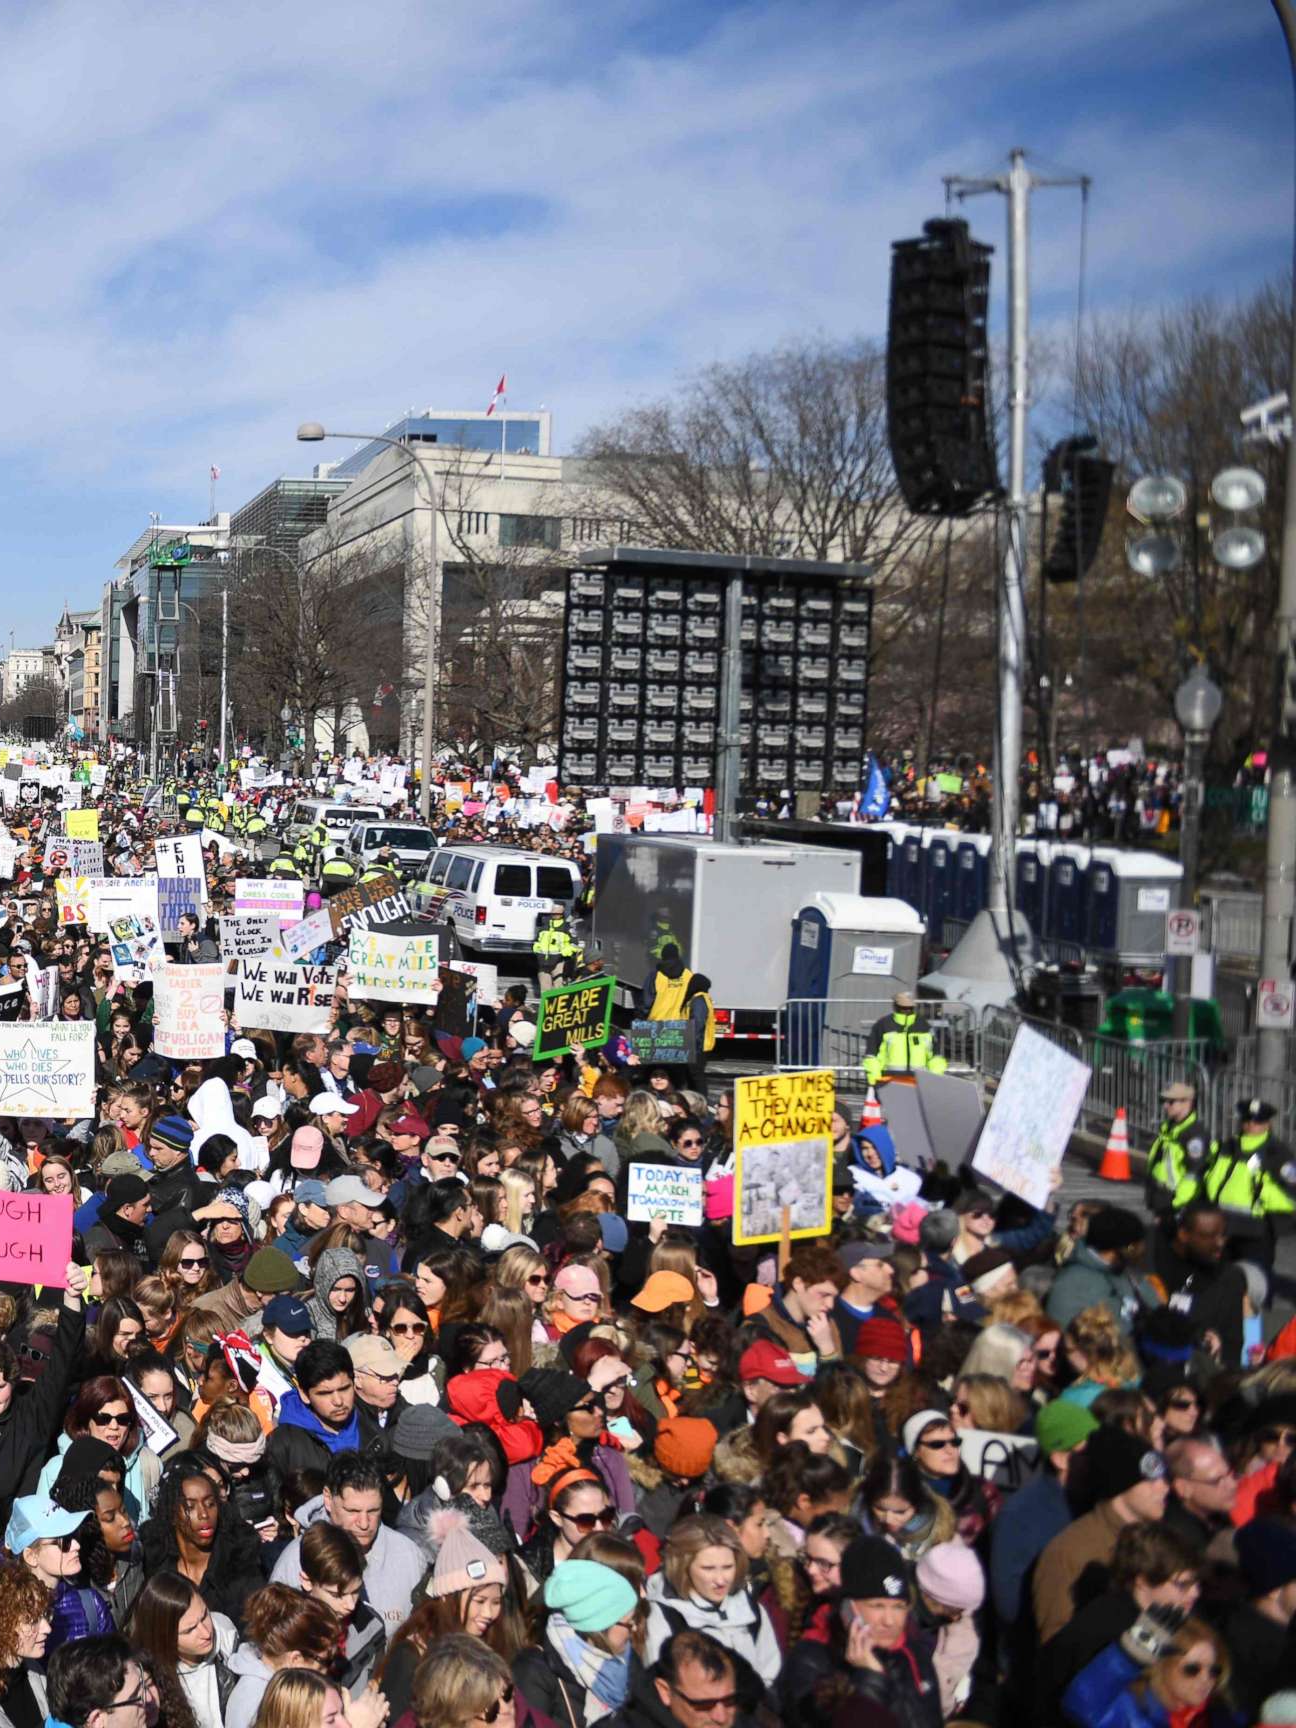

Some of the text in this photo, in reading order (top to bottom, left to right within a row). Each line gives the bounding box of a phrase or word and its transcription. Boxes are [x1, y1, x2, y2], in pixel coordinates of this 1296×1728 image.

[124, 879, 155, 887] America
[158, 878, 201, 893] MARCH
[168, 891, 190, 904] FOR
[64, 904, 85, 921] BS
[340, 892, 411, 931] ENOUGH
[453, 906, 474, 920] POLICE
[350, 950, 395, 969] GREAT
[180, 991, 192, 1007] 2
[545, 987, 602, 1015] WE ARE
[177, 1008, 198, 1019] BUY
[542, 1008, 591, 1032] GREAT
[566, 1023, 604, 1045] MILLS
[4, 1049, 58, 1059] WHO LIVES
[6, 1062, 52, 1072] WHO DIES
[5, 1074, 30, 1084] TELLS
[33, 1074, 49, 1084] OUR
[51, 1072, 86, 1086] STORY?
[741, 1074, 834, 1098] THE TIMES
[749, 1096, 824, 1118] THEY ARE
[632, 1167, 701, 1184] TODAY WE
[645, 1184, 689, 1197] MARCH
[689, 1200, 700, 1208] WE
